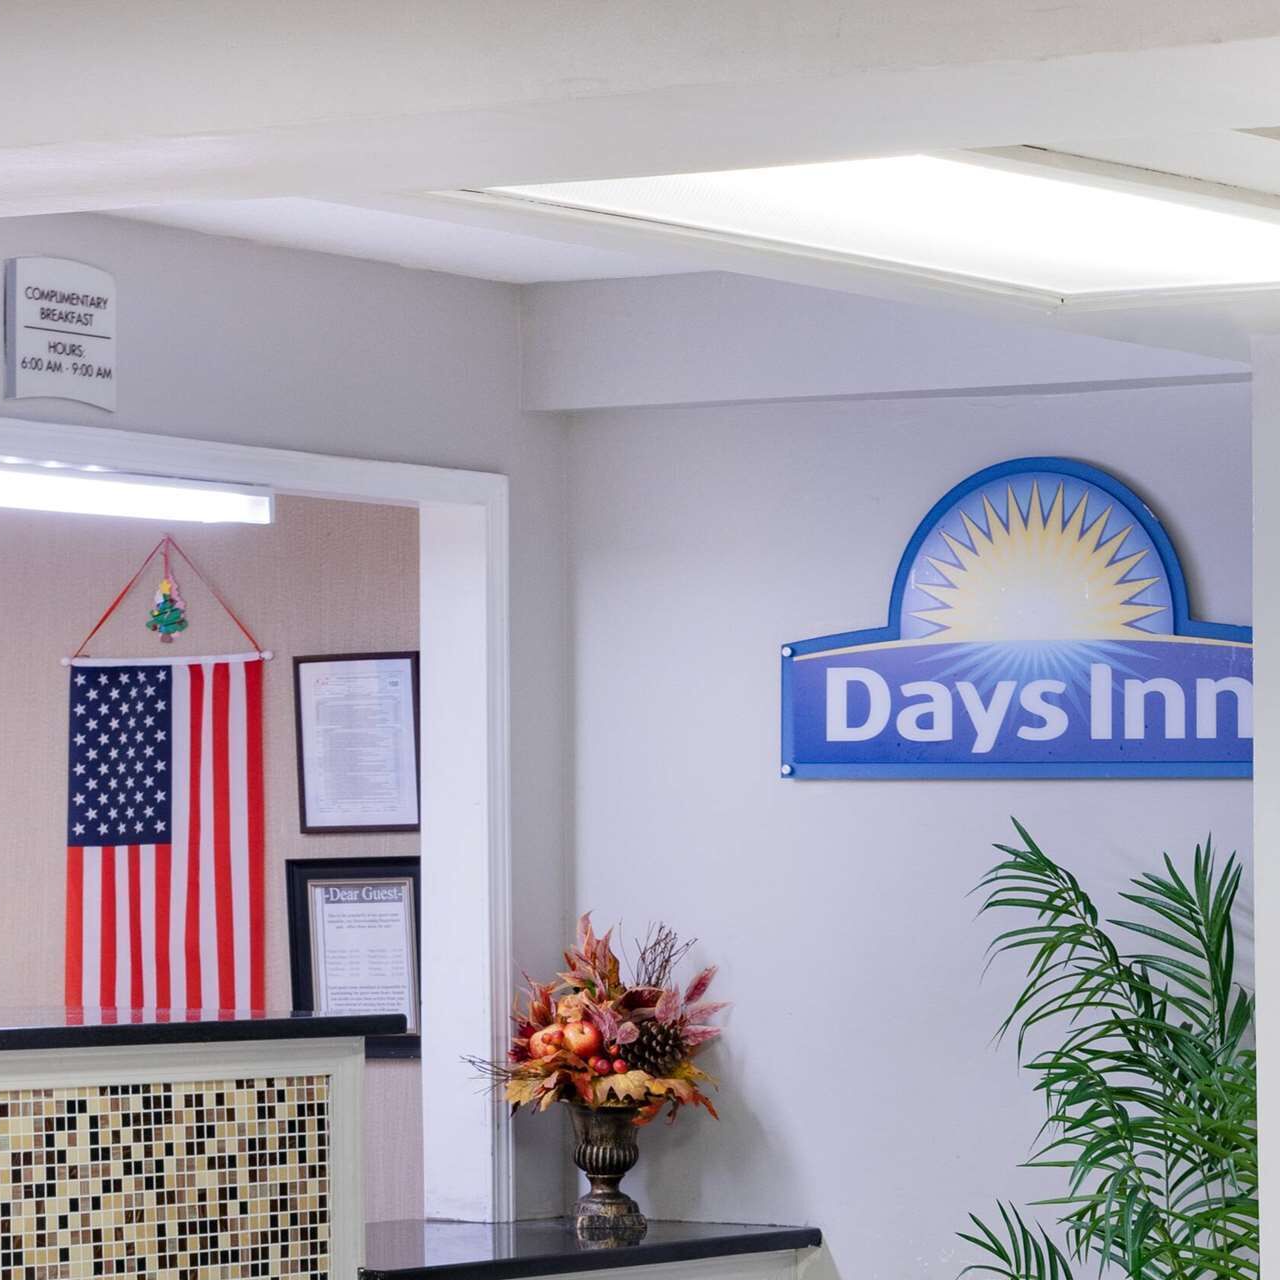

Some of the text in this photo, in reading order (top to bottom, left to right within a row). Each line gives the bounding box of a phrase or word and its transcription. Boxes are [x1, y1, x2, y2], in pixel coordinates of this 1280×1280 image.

[24, 286, 109, 310] COMPLIMENTARY
[40, 307, 94, 327] BREAKFAST
[21, 357, 43, 371] 6:00
[46, 360, 63, 373] AM
[71, 362, 94, 377] 9:00
[96, 366, 112, 379] AM
[825, 663, 1253, 753] Days Inn
